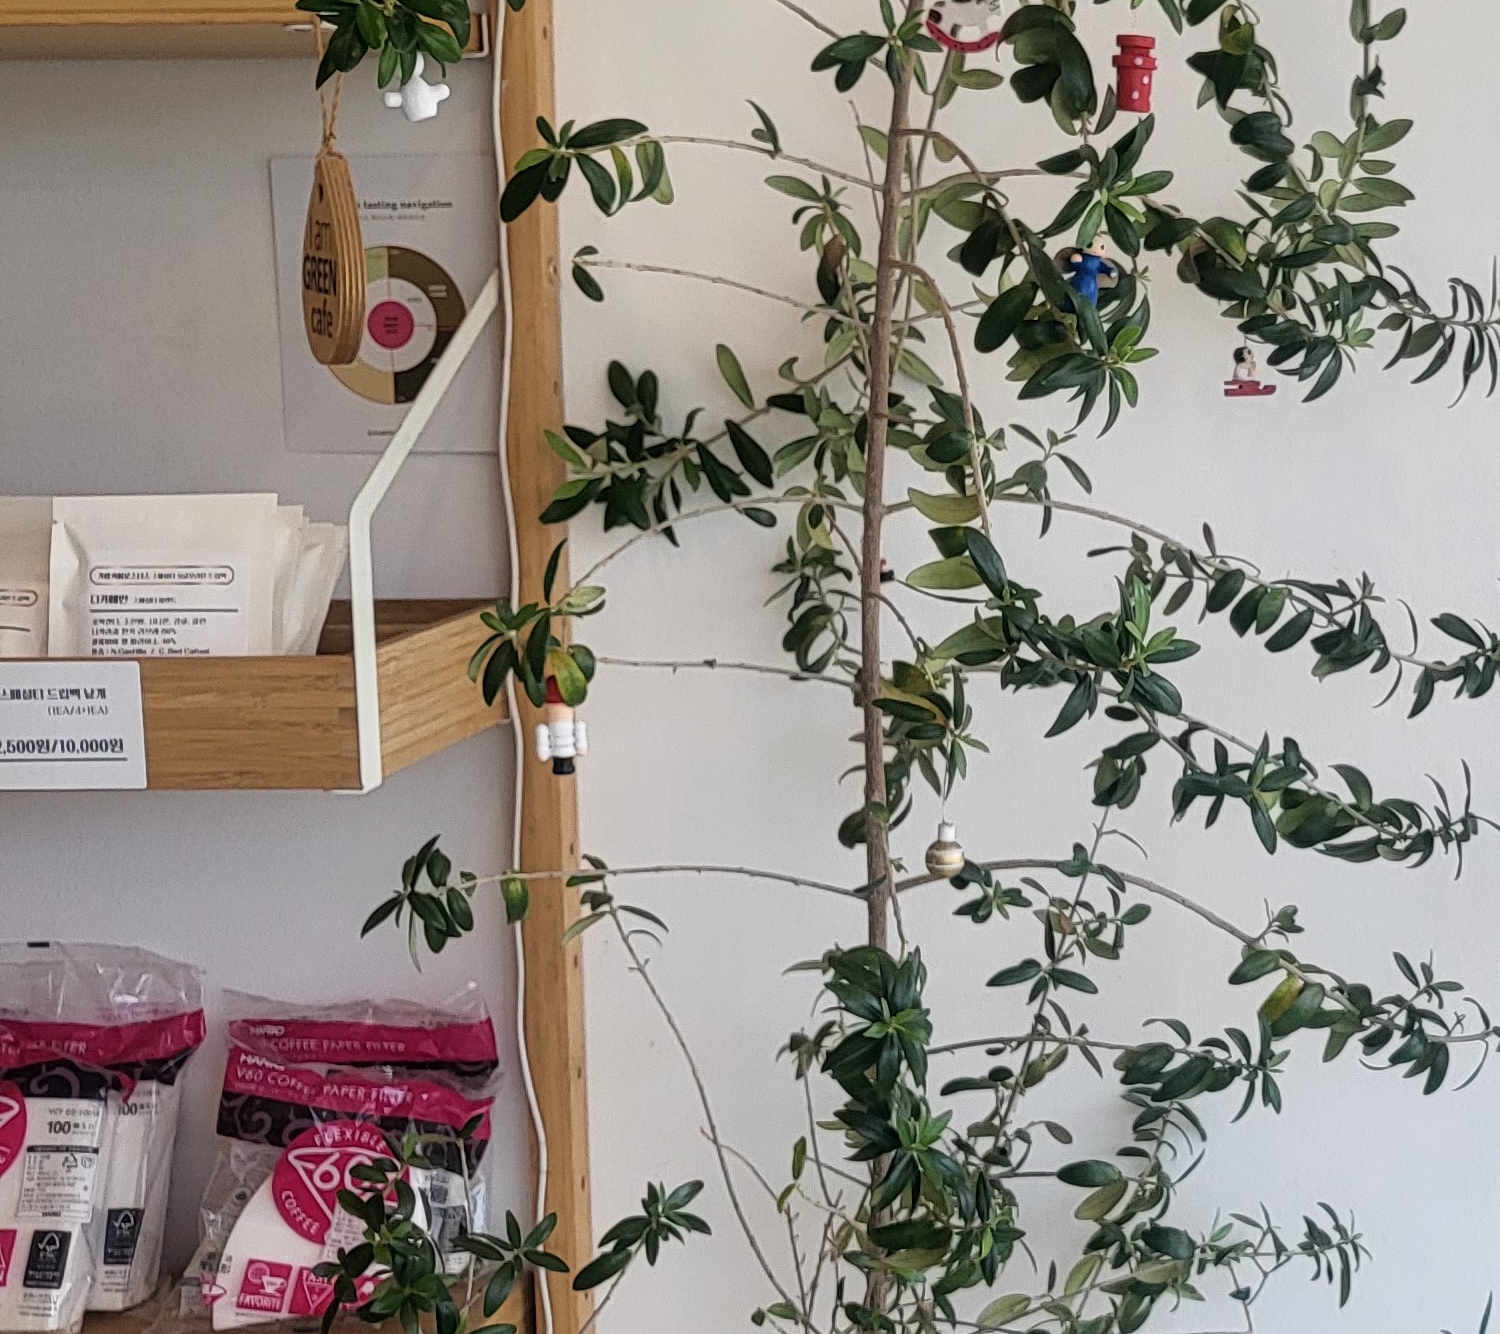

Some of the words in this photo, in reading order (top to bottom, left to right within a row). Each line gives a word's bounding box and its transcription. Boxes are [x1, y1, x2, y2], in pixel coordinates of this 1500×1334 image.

[314, 220, 331, 252] am
[302, 253, 337, 297] GREEN
[47, 687, 81, 701] 드립백
[271, 1038, 319, 1051] COFFEE
[323, 1039, 361, 1051] PAPER
[366, 1041, 405, 1053] FILTER
[237, 1066, 263, 1081] V60
[323, 1084, 366, 1101] PAPER
[47, 1121, 71, 1134] 100
[313, 1128, 388, 1152] FLEXIBLE
[281, 1190, 320, 1236] COFFEE
